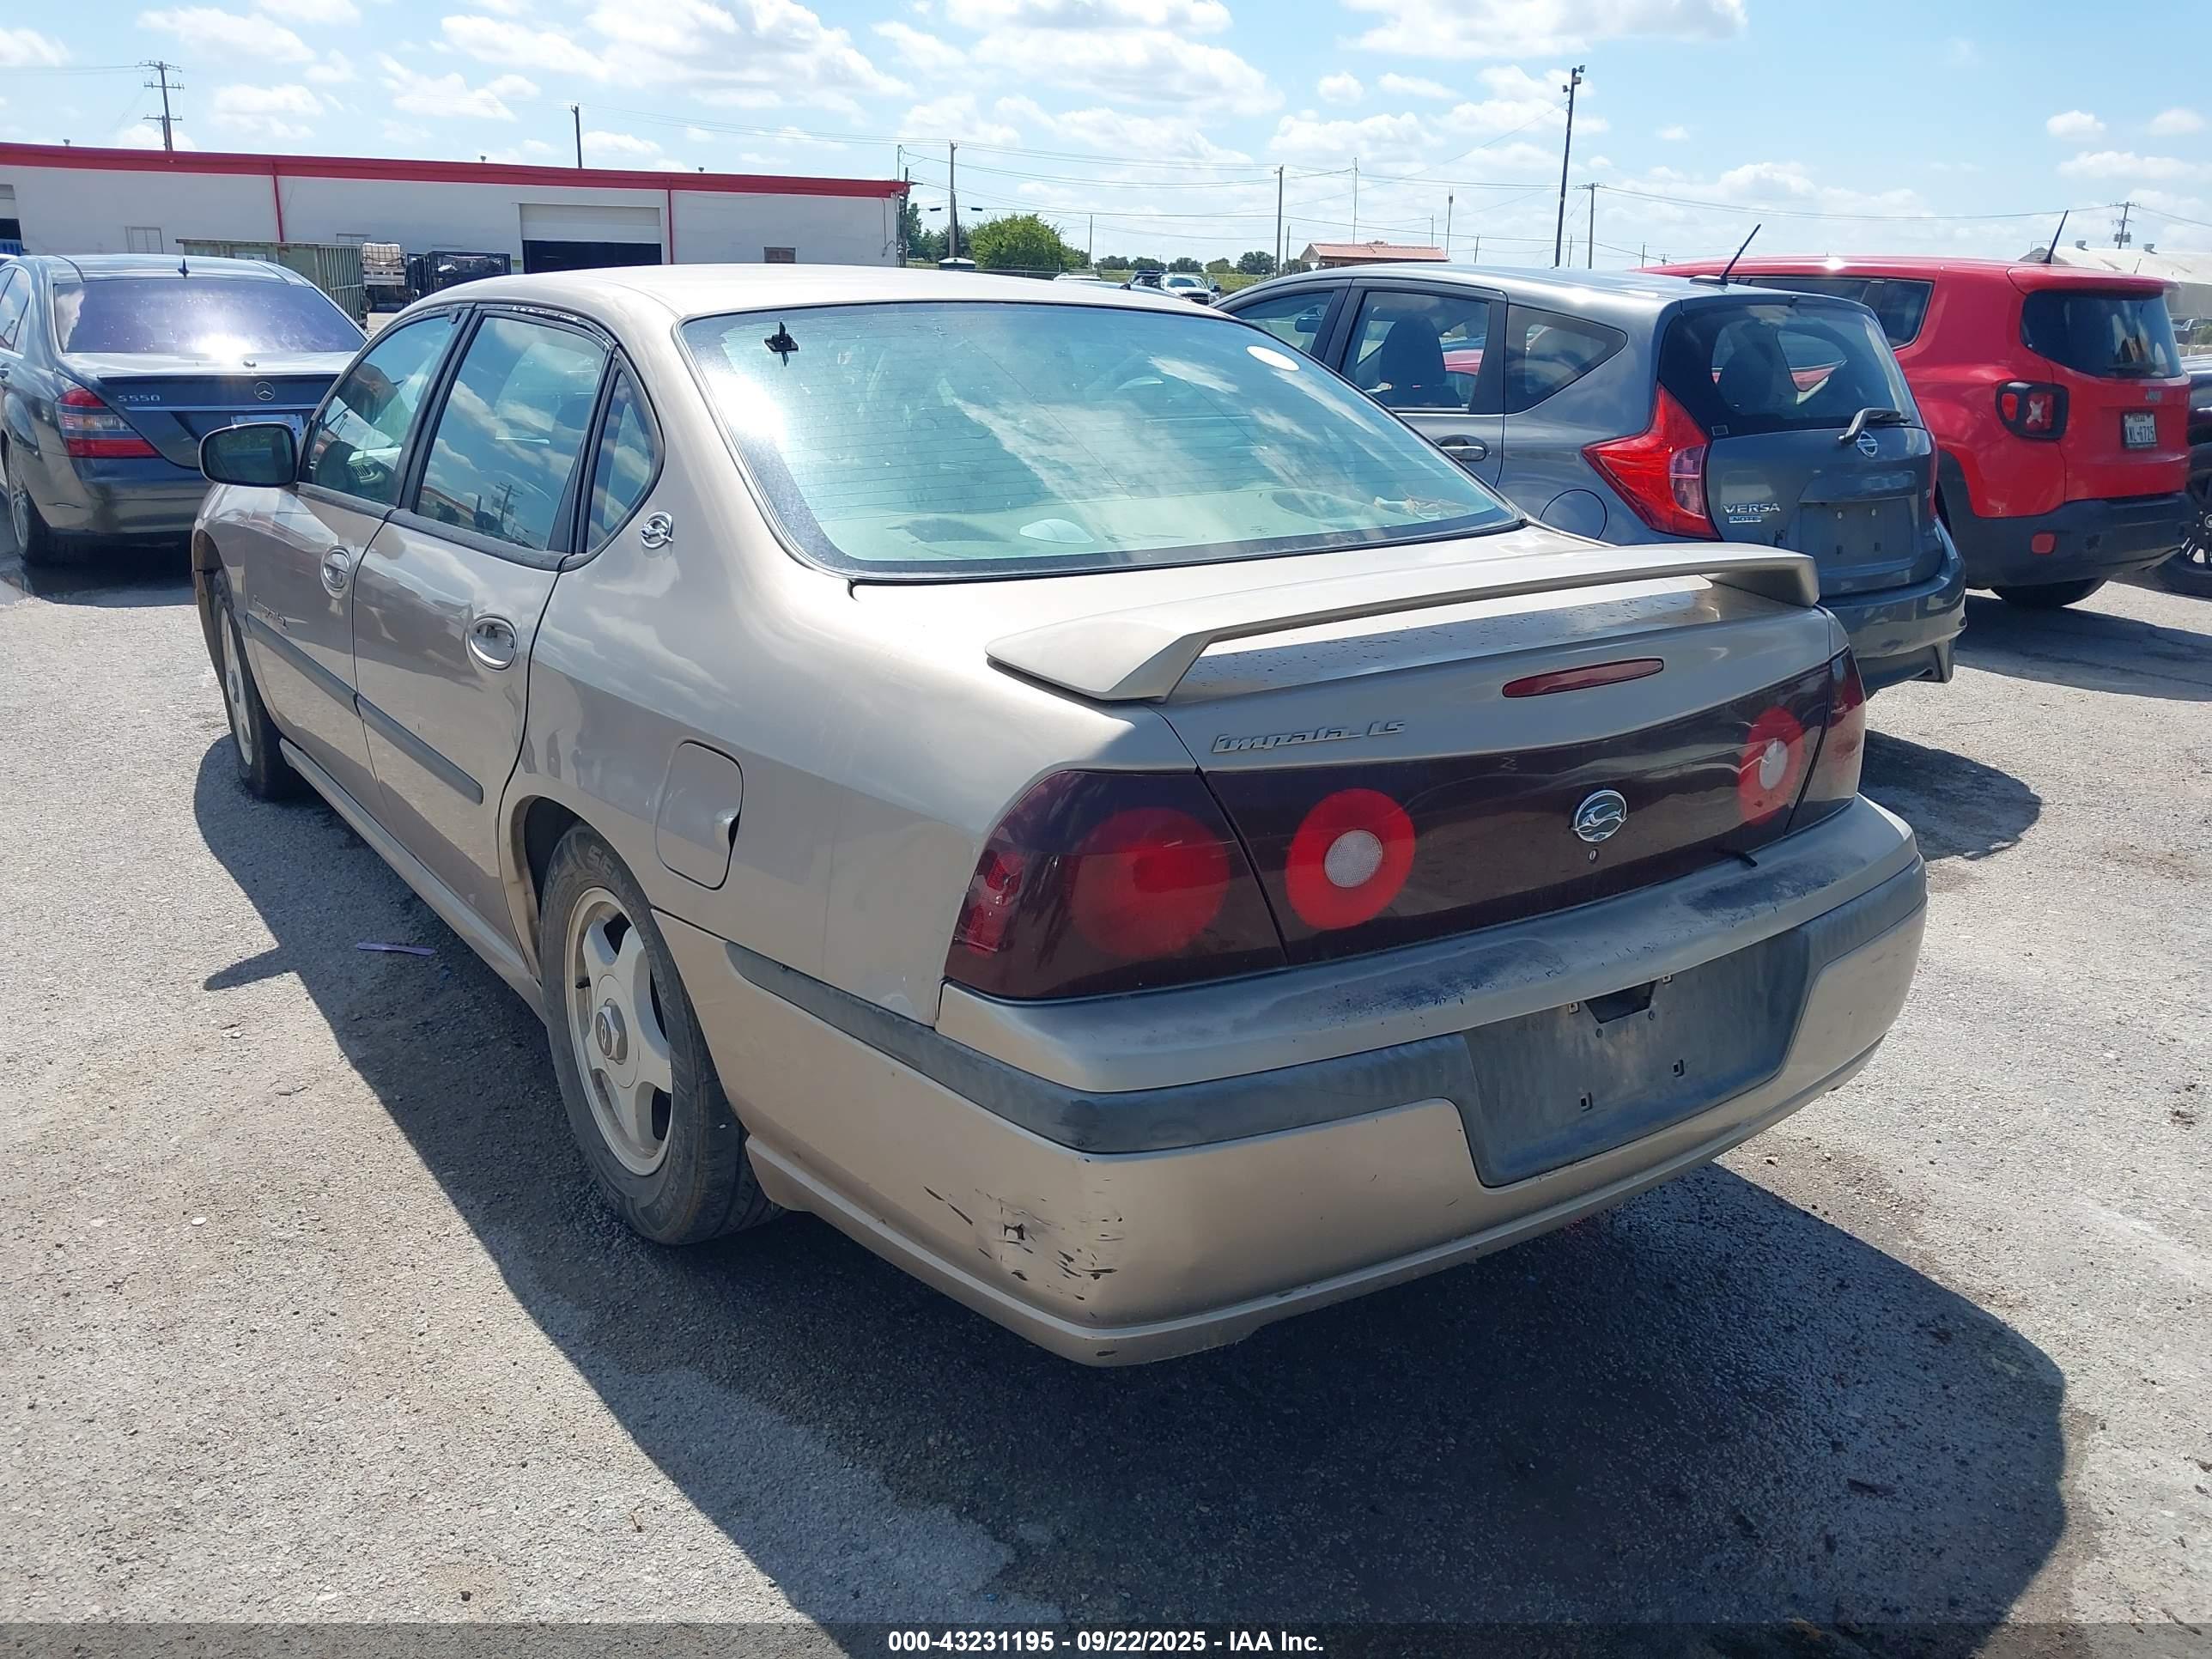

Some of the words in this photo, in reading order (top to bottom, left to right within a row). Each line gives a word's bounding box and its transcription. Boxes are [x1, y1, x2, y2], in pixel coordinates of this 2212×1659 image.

[1722, 502, 1781, 514] VERSA
[1212, 726, 1364, 753] Impala
[1368, 720, 1406, 736] LS
